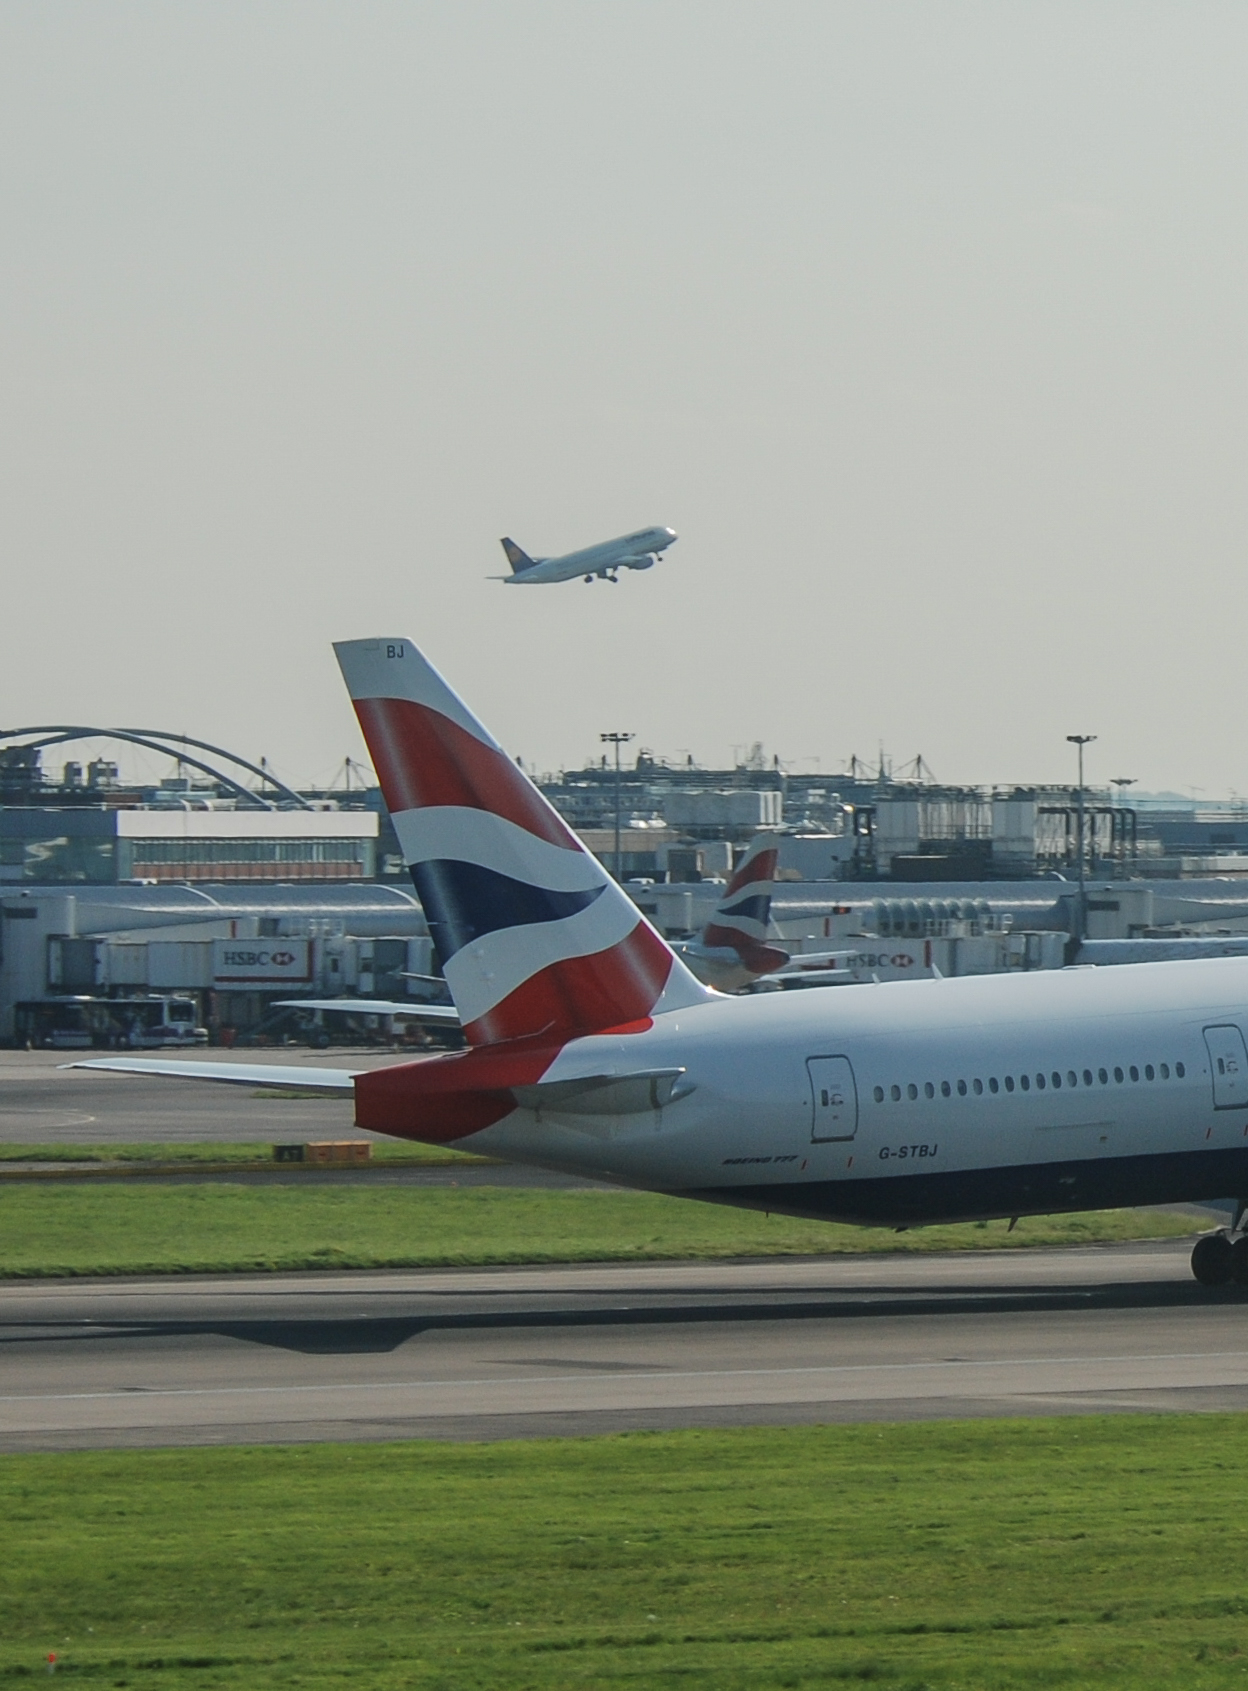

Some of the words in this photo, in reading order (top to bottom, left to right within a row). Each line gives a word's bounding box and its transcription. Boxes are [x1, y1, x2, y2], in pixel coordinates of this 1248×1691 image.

[387, 645, 404, 658] BJ
[223, 952, 269, 966] HSBC
[846, 954, 888, 967] HSBC
[879, 1144, 938, 1159] G-STBJ
